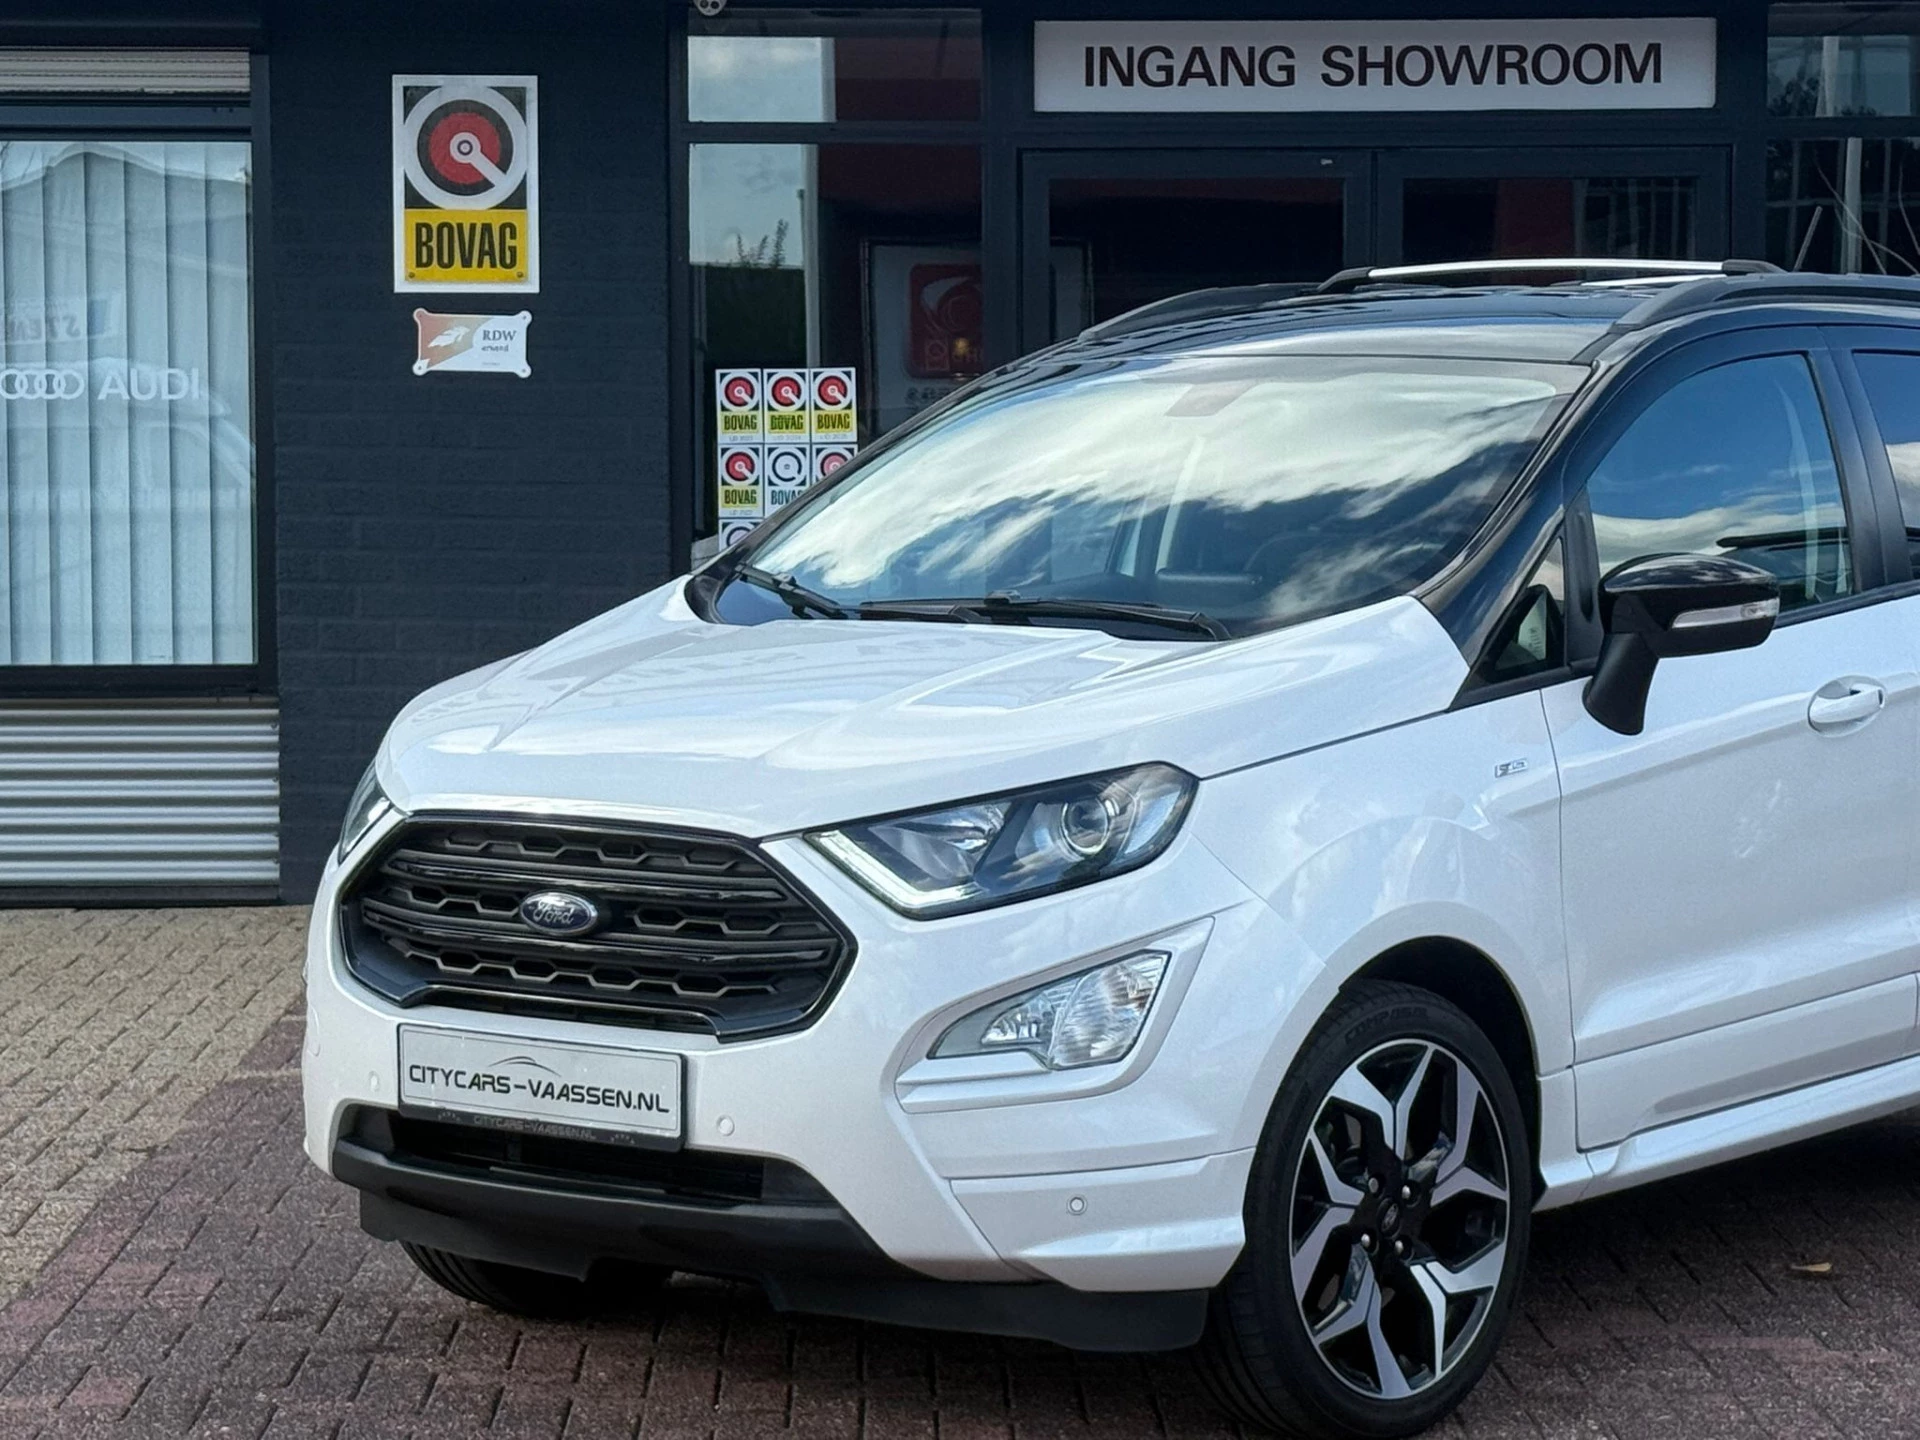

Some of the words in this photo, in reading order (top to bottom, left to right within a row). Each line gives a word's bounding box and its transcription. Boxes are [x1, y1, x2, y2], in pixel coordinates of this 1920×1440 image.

[1085, 44, 1296, 88] INGANG
[1321, 43, 1662, 86] SHOWROOM
[415, 222, 517, 270] BOVAG
[482, 329, 517, 341] RDW
[97, 367, 200, 401] AUDI
[724, 414, 757, 431] BOVAG
[770, 414, 804, 431] BOVAG
[817, 413, 851, 430] BOVAG
[724, 489, 757, 505] BOVAG
[530, 899, 575, 925] Ford
[408, 1064, 670, 1114] CITYCARS-VAASSEN.NL
